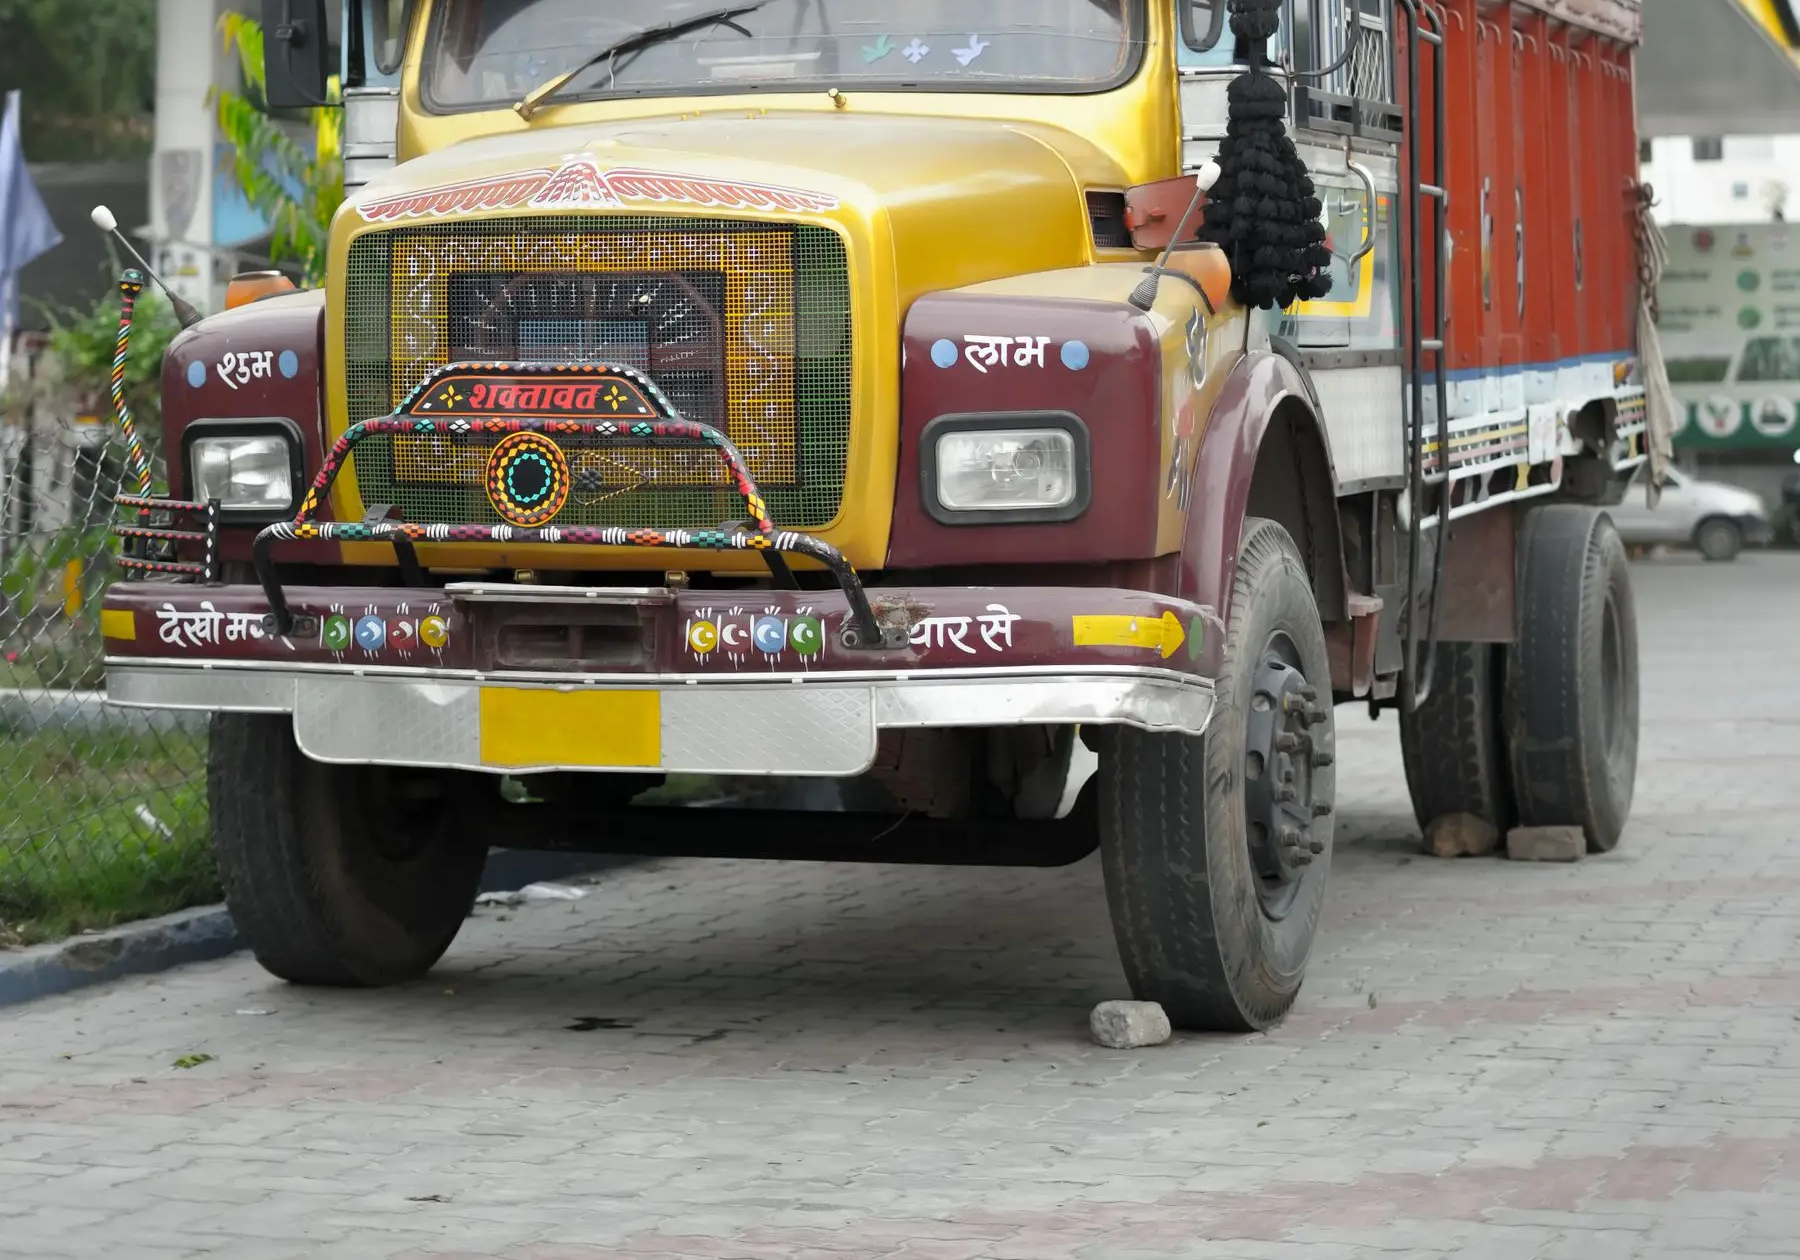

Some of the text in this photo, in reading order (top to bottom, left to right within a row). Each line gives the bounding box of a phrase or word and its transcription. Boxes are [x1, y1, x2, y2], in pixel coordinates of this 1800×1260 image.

[217, 351, 274, 390] शुभ
[963, 334, 1051, 373] लाभ
[469, 383, 604, 410] शक्तावत
[155, 601, 225, 648] देखो
[976, 603, 1022, 652] से
